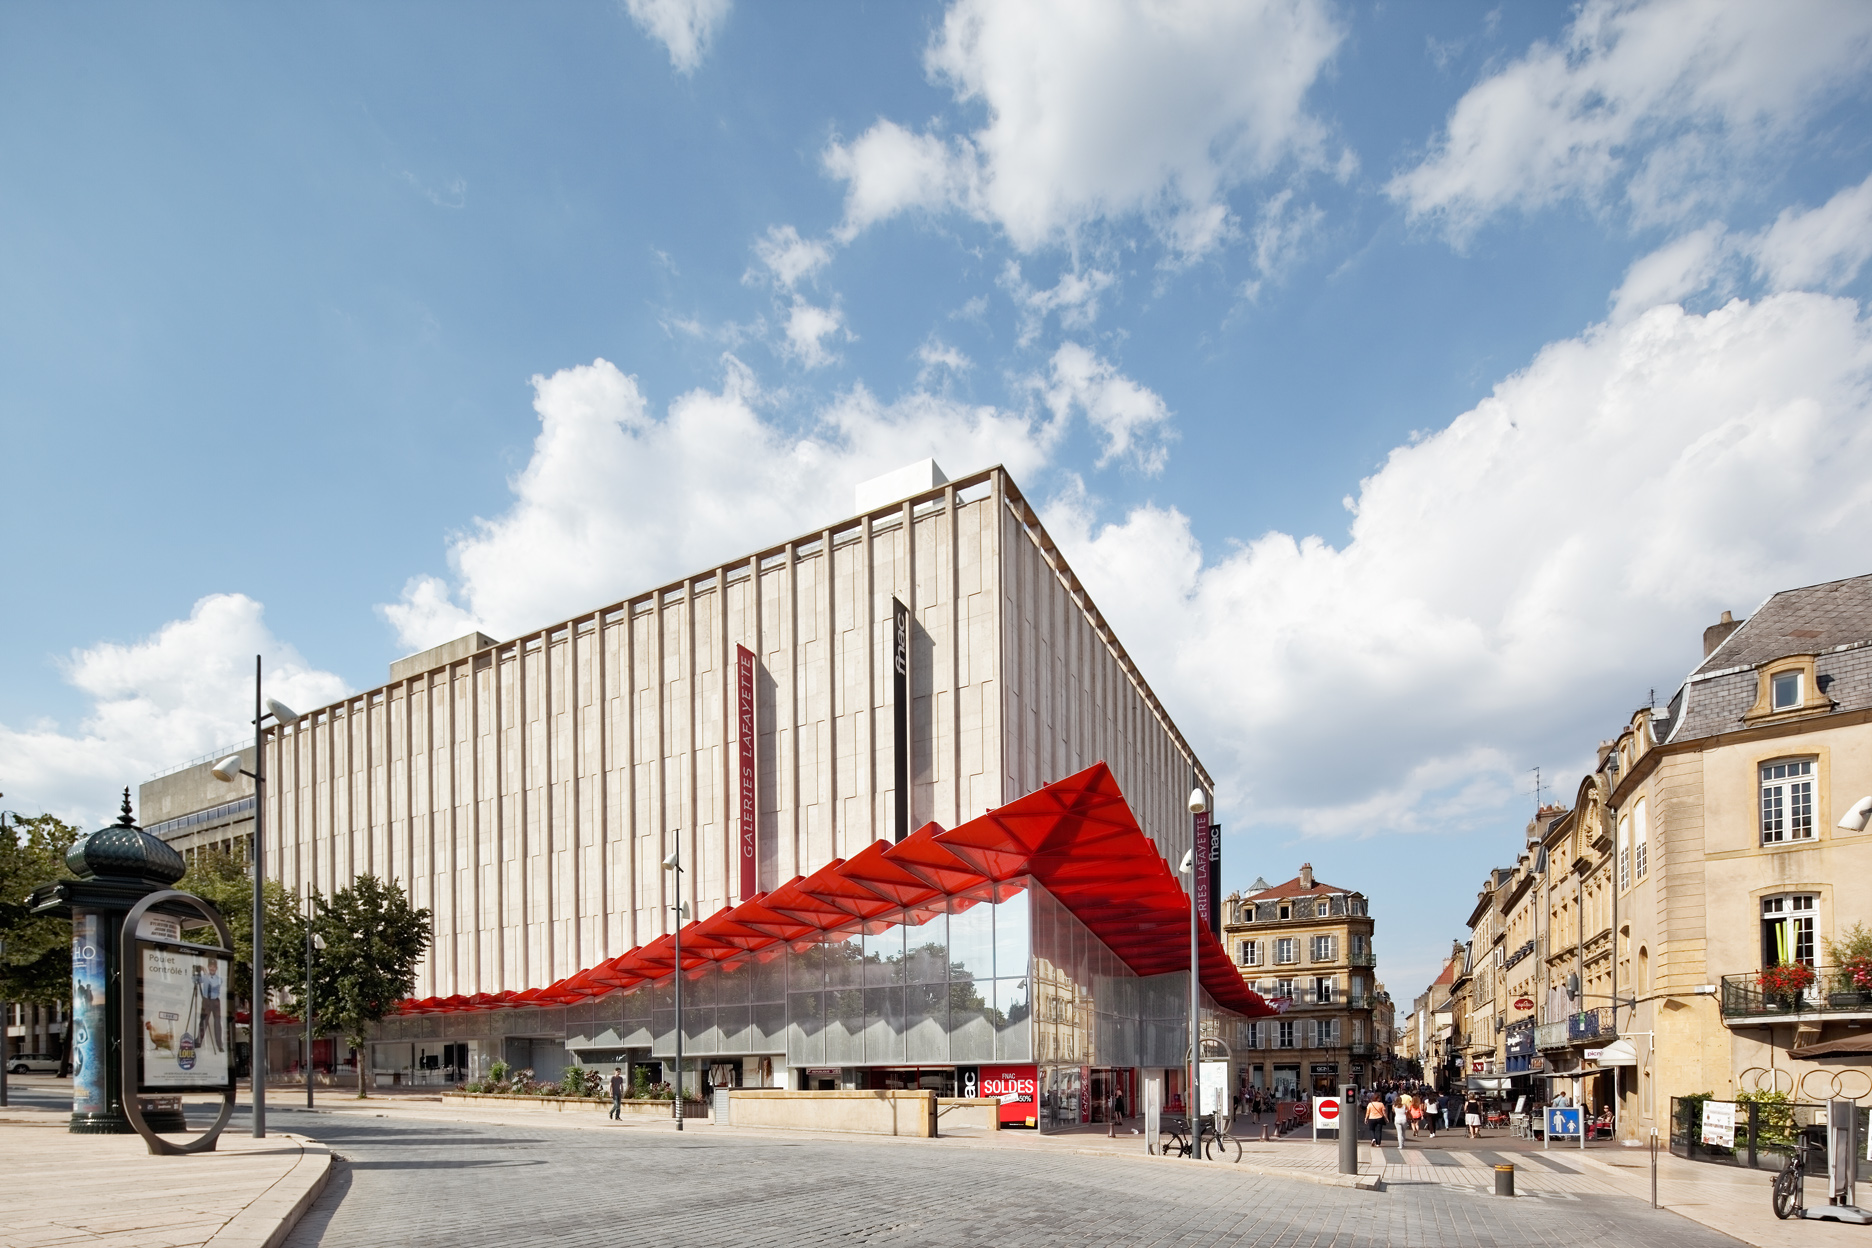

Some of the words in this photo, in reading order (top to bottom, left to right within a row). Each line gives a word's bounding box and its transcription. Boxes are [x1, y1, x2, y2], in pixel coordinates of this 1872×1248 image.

[895, 612, 905, 676] fnac
[740, 655, 752, 758] LAFAYETTE
[743, 766, 753, 858] GALERIES
[1196, 817, 1207, 880] LAFAYETTE
[1209, 828, 1219, 862] fnac
[1198, 884, 1208, 921] ERIES
[149, 953, 175, 965] Poulet
[149, 965, 183, 976] contrôlé
[964, 1072, 976, 1098] ac
[984, 1079, 1034, 1094] SOLDES
